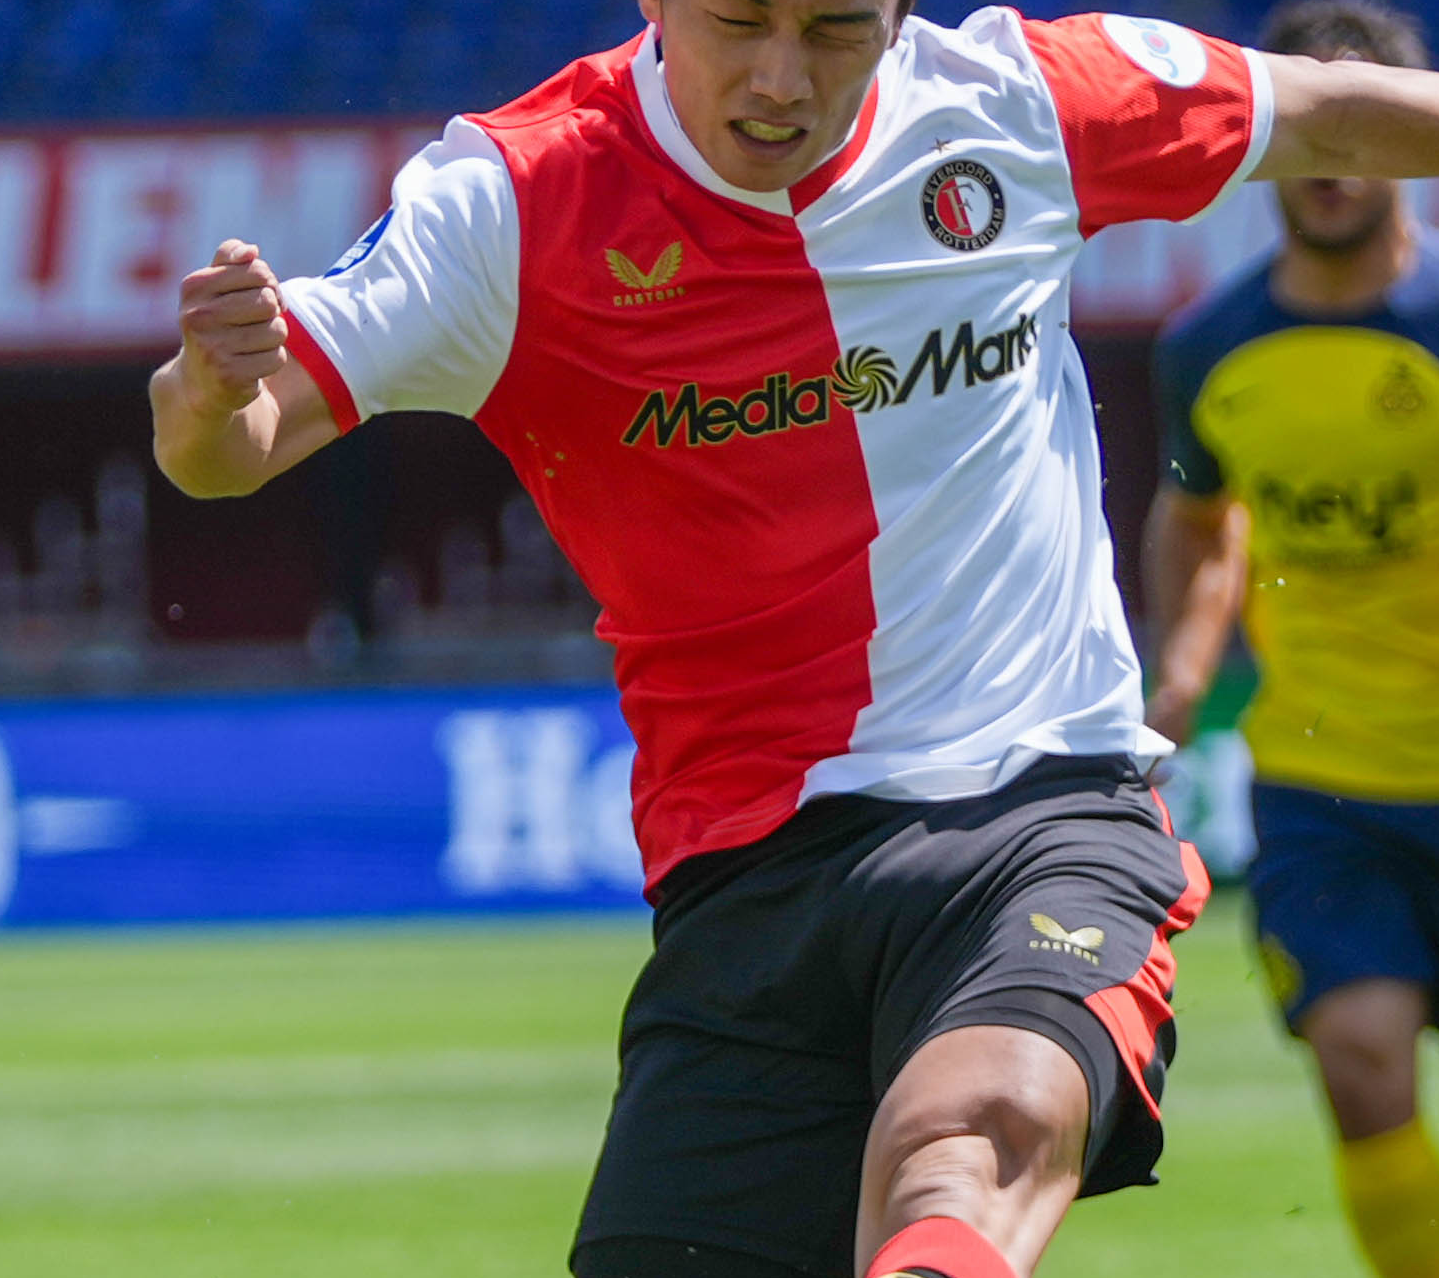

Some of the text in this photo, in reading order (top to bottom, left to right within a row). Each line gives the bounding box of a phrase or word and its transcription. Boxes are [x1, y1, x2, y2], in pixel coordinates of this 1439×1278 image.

[922, 162, 993, 204] FEYENOORD
[933, 207, 1004, 251] ROTTERDAM
[621, 371, 831, 449] Media
